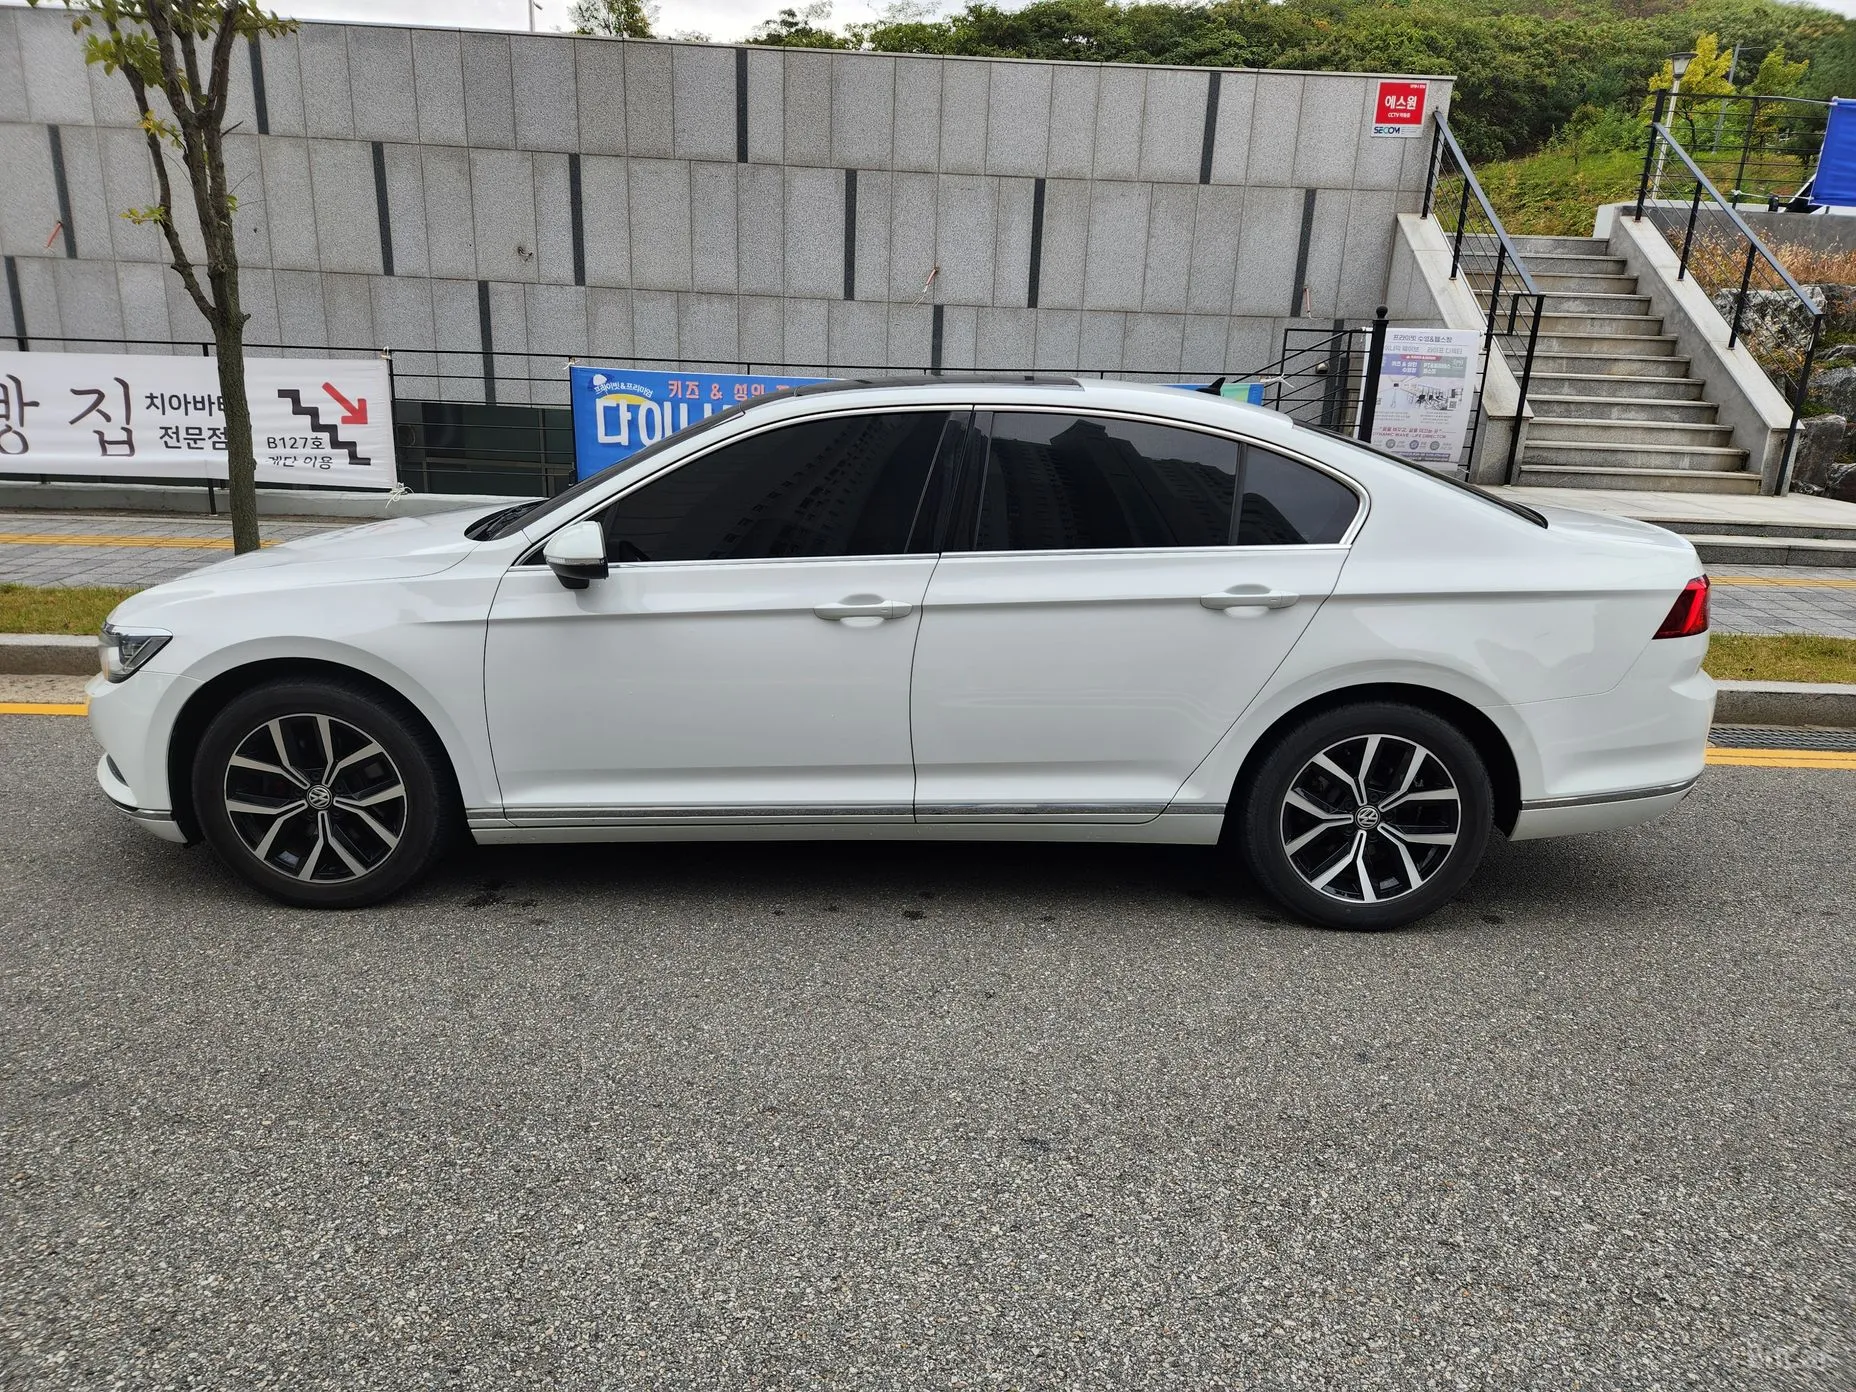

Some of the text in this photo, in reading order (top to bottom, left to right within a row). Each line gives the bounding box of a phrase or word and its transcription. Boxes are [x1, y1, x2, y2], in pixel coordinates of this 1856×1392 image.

[1385, 95, 1417, 110] 에스원
[1373, 126, 1401, 134] SECOM
[668, 380, 700, 399] 키즈
[710, 384, 723, 400] &
[68, 377, 136, 457] 집
[159, 425, 228, 451] 전문점
[267, 436, 326, 450] B127호
[303, 456, 333, 470] 이용
